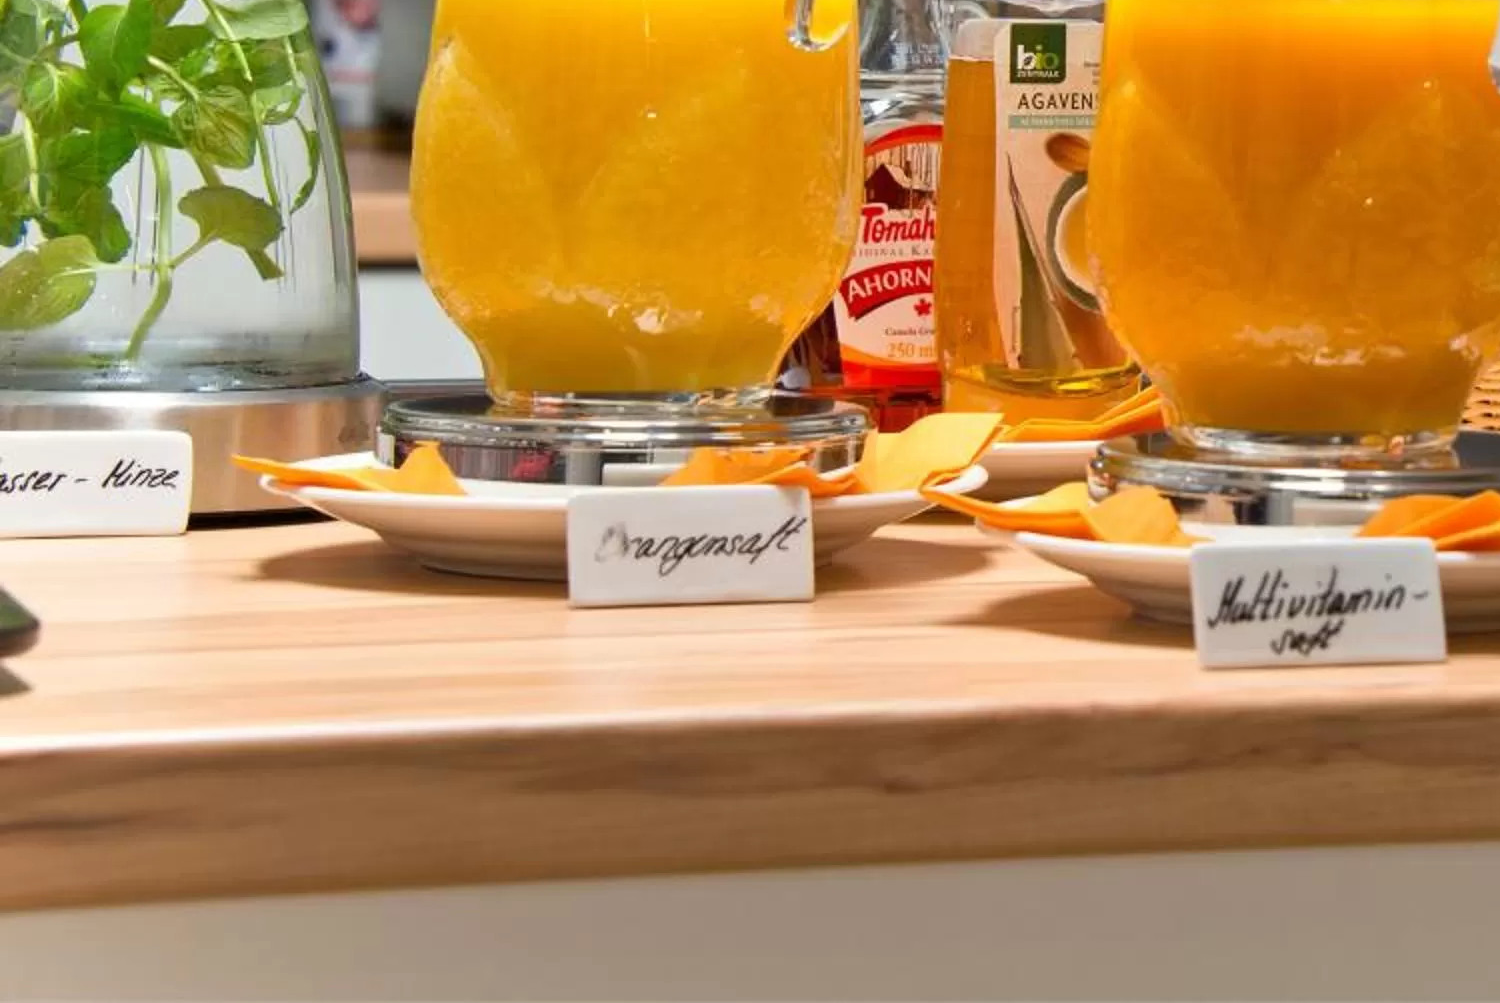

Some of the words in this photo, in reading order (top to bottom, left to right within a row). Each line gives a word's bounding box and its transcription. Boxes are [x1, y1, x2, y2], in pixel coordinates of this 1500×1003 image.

[1017, 44, 1060, 70] bio
[861, 204, 936, 244] Tomah
[848, 266, 933, 304] AHORN
[0, 457, 67, 494] asser
[593, 515, 808, 578] Orangensaft
